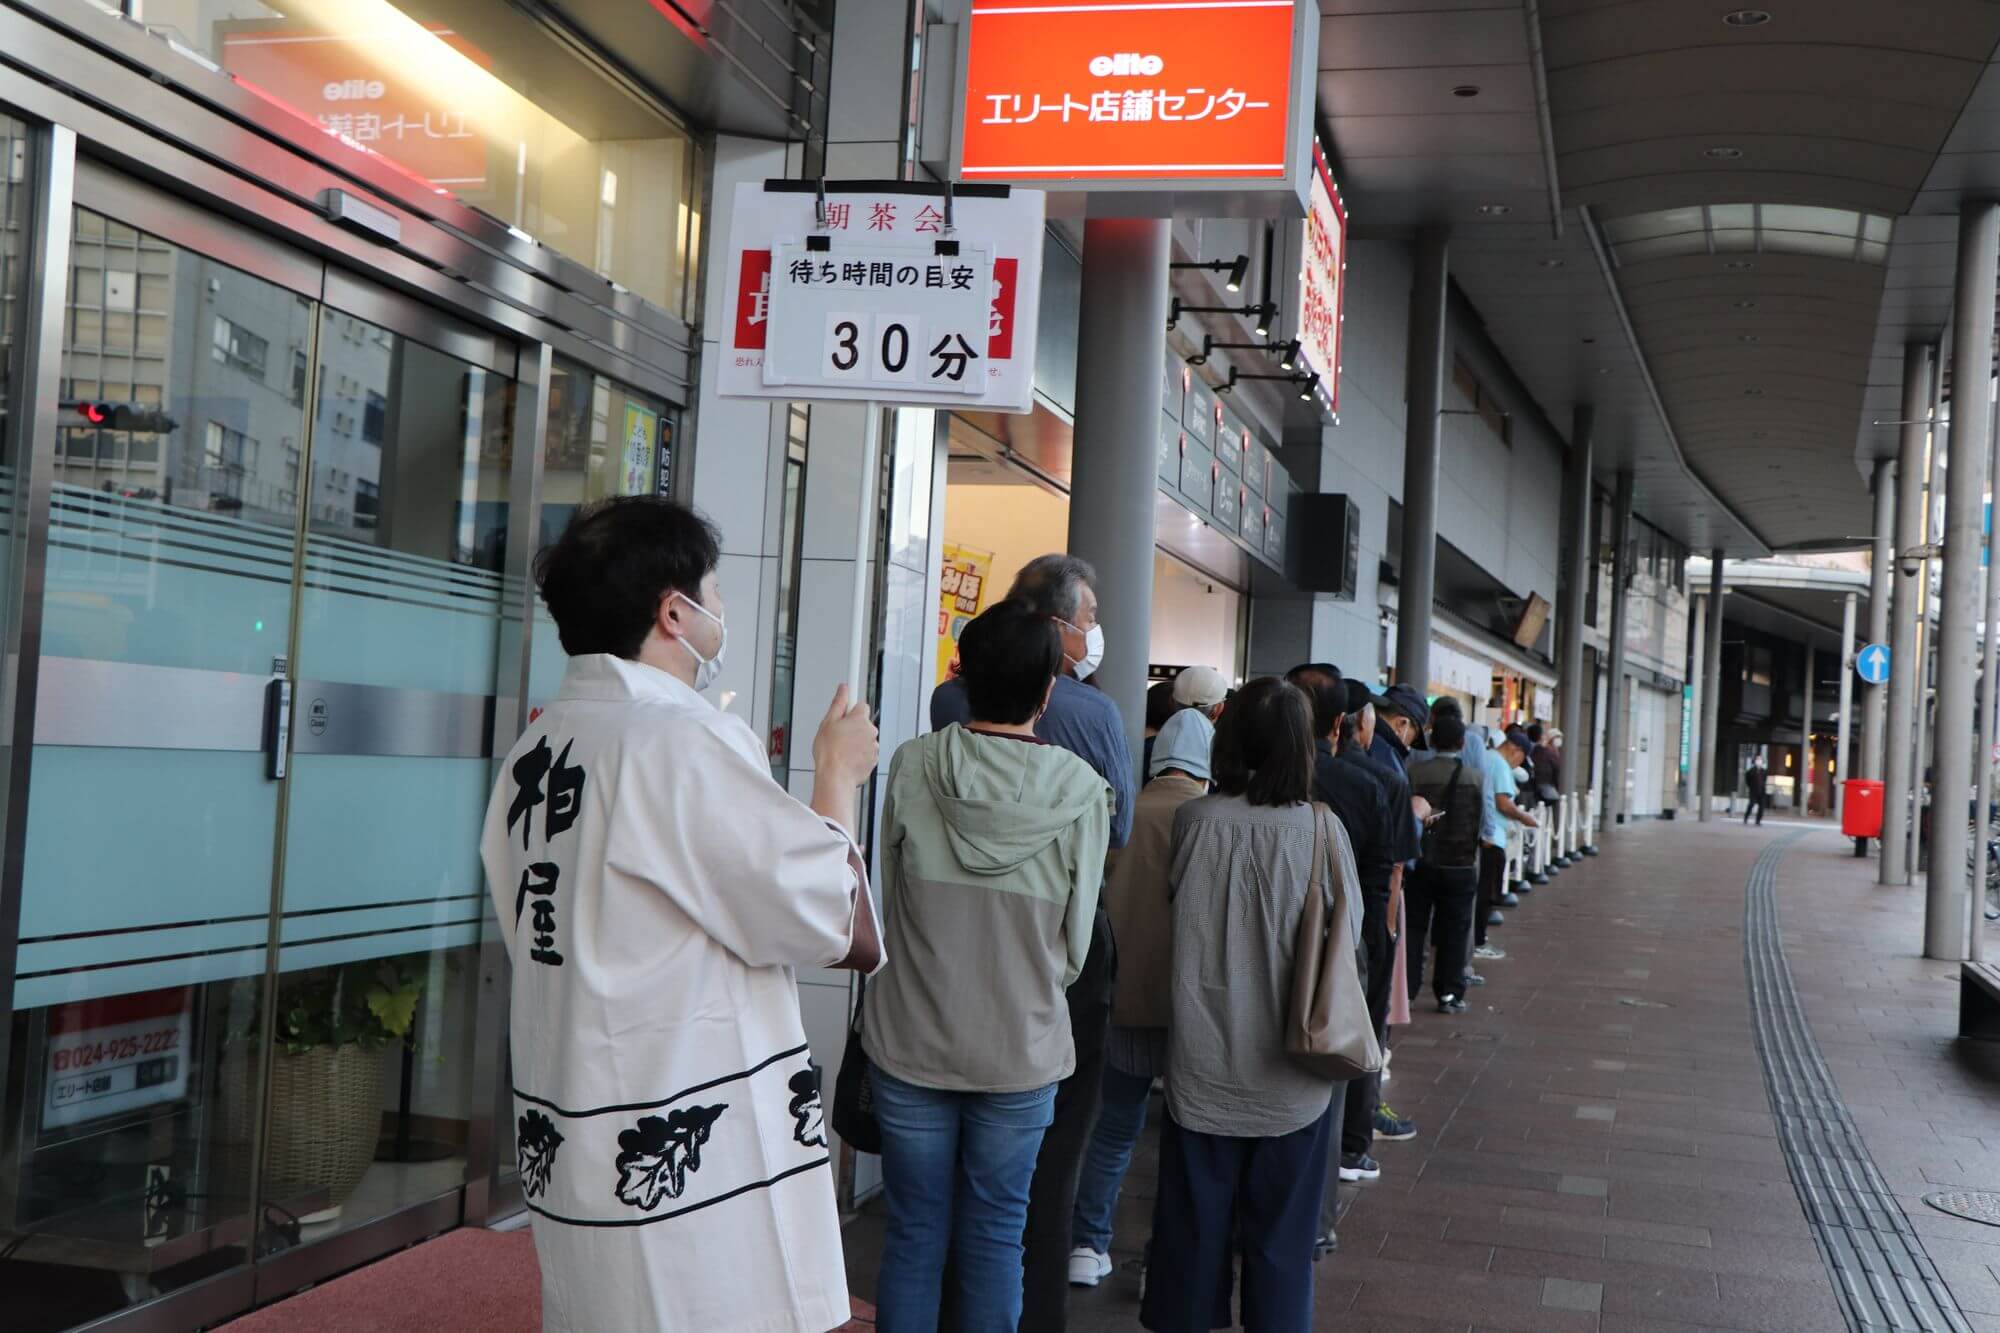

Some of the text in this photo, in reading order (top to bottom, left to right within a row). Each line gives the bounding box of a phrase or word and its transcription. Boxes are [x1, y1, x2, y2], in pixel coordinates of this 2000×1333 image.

[981, 87, 1270, 125] エリート店舗センター
[788, 258, 975, 291] 待ち時間の目安
[507, 734, 586, 967] 柏屋
